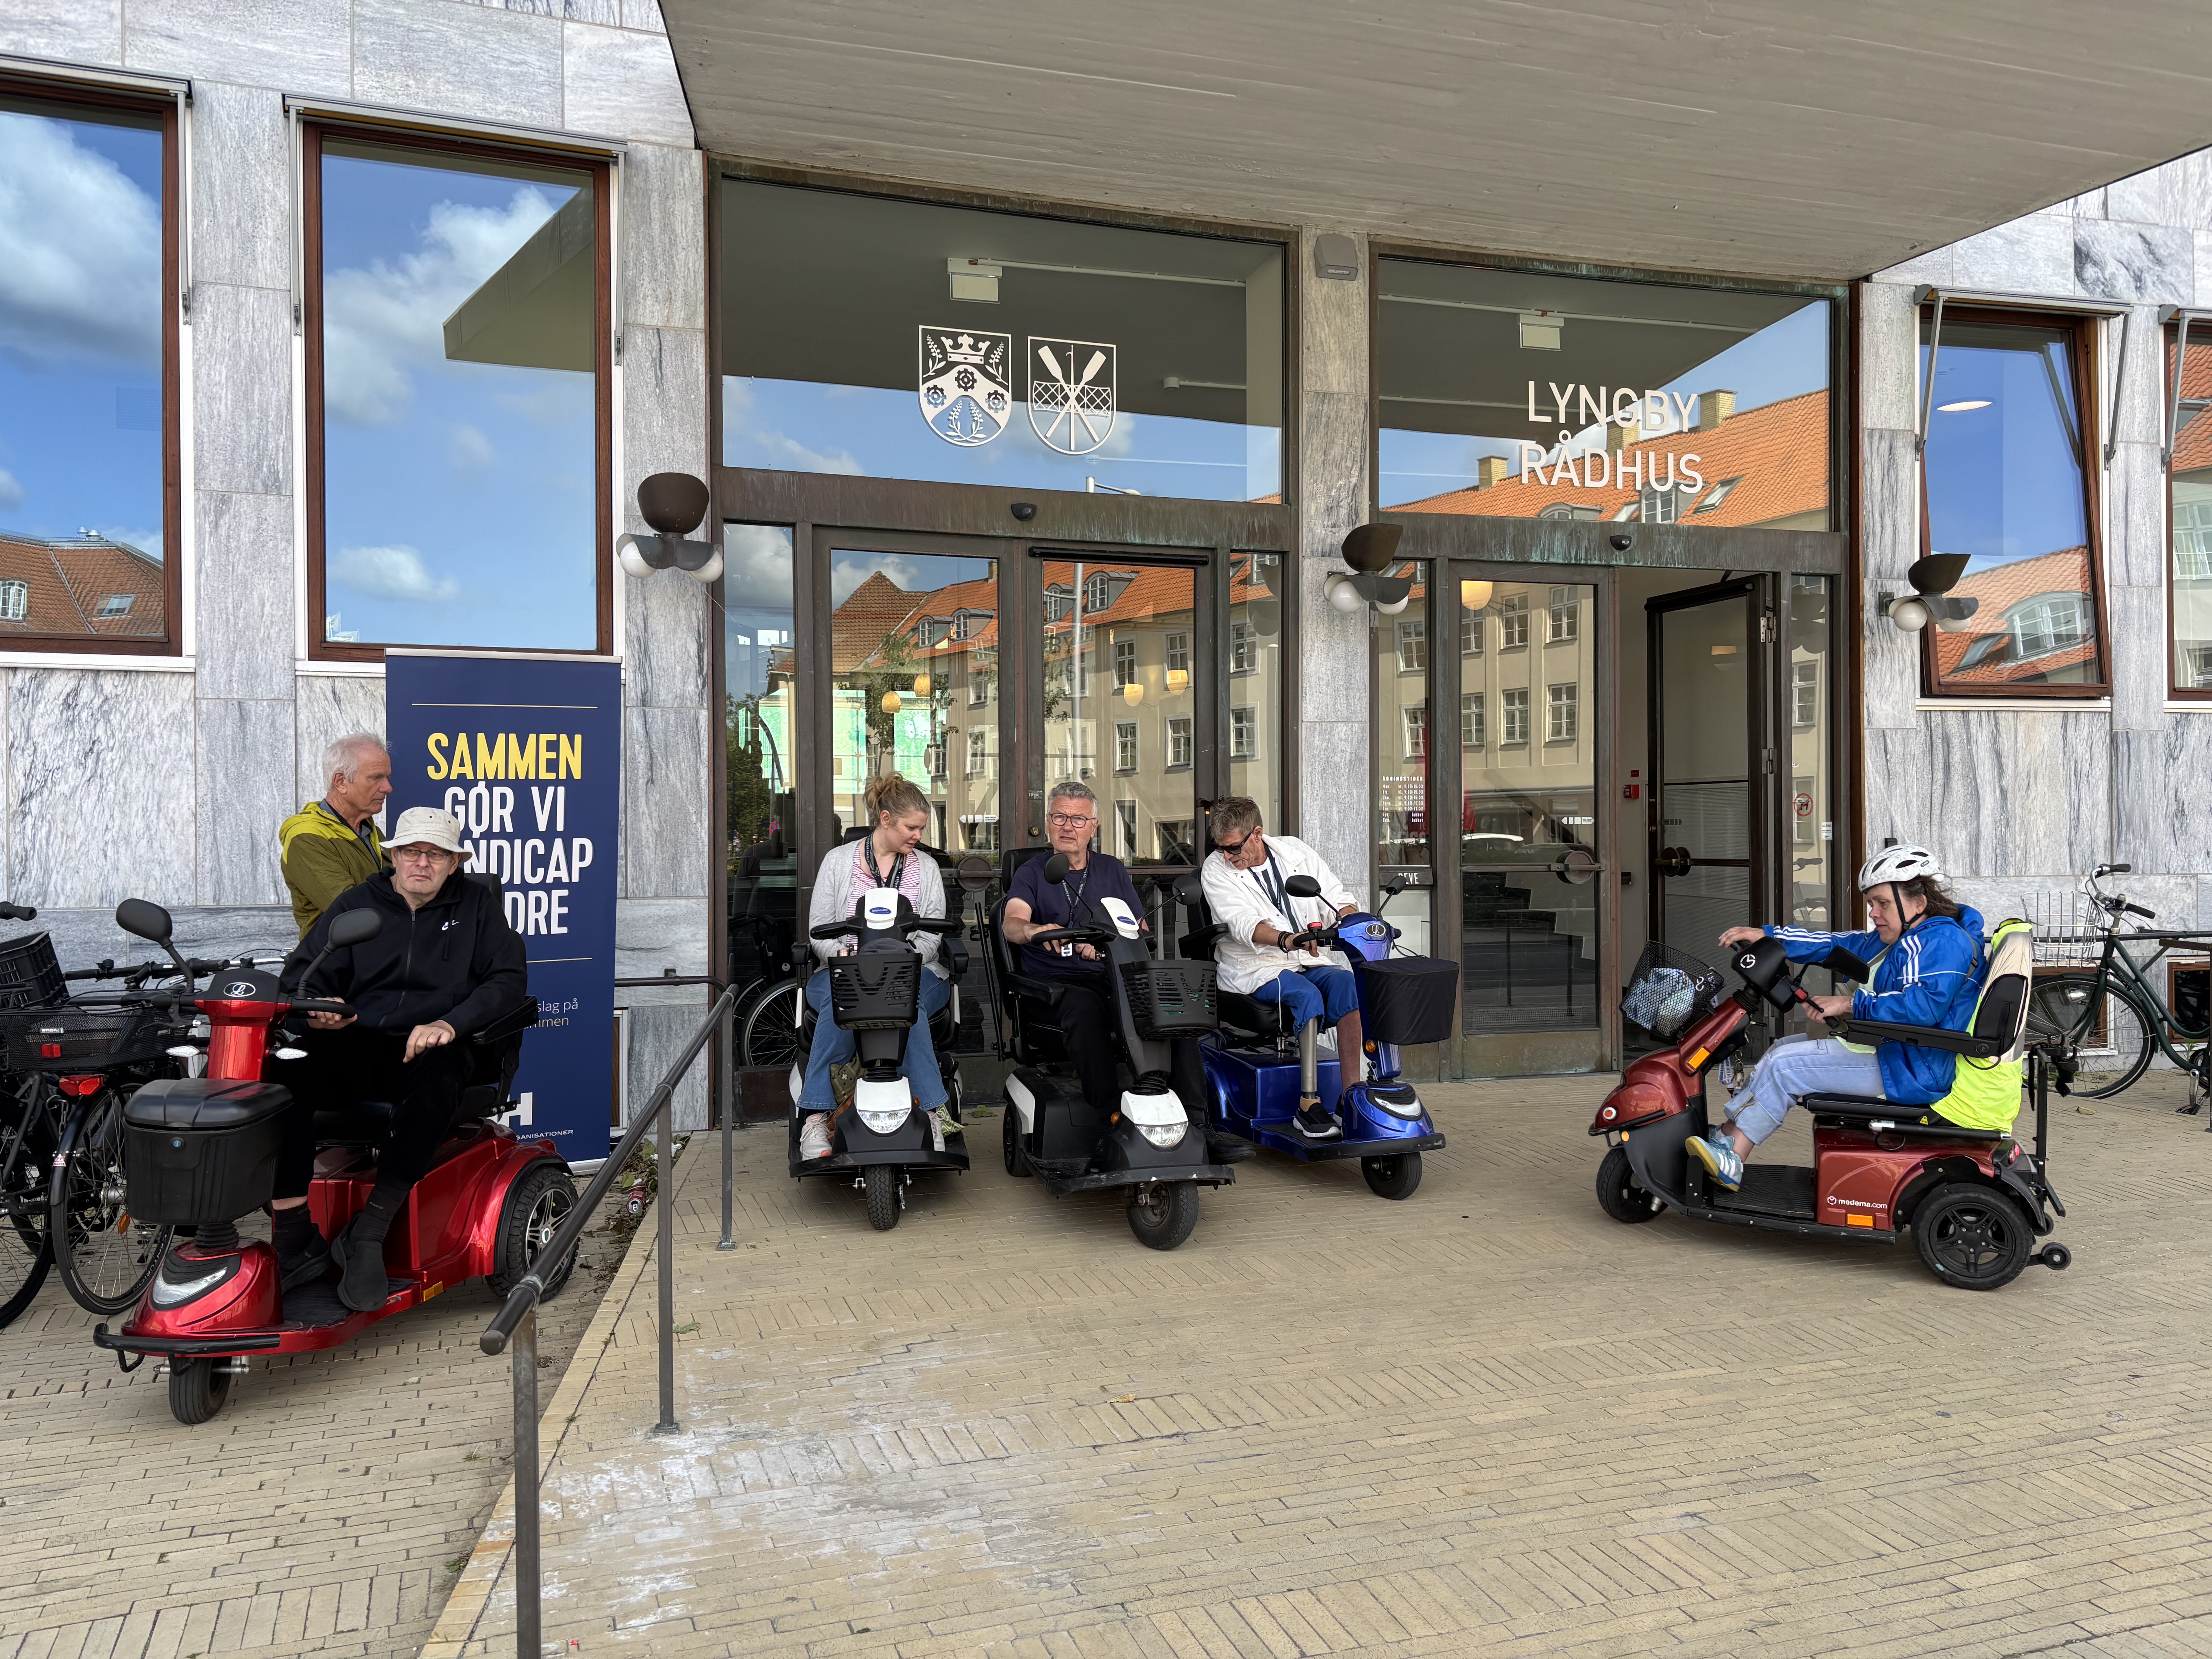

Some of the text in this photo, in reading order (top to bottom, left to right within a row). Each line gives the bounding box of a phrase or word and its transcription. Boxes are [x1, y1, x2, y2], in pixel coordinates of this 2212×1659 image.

[1528, 380, 1698, 432] LYNGBY
[1520, 429, 1704, 494] RÅDHUS
[427, 732, 582, 780] SAMMEN
[444, 781, 565, 838] GØR VI
[464, 838, 594, 885] NDICAP
[504, 889, 569, 936] DRE
[536, 998, 578, 1014] slag på
[486, 1092, 533, 1127] H
[516, 1129, 574, 1140] GANISATIONER
[1838, 1199, 1887, 1209] medema.com
